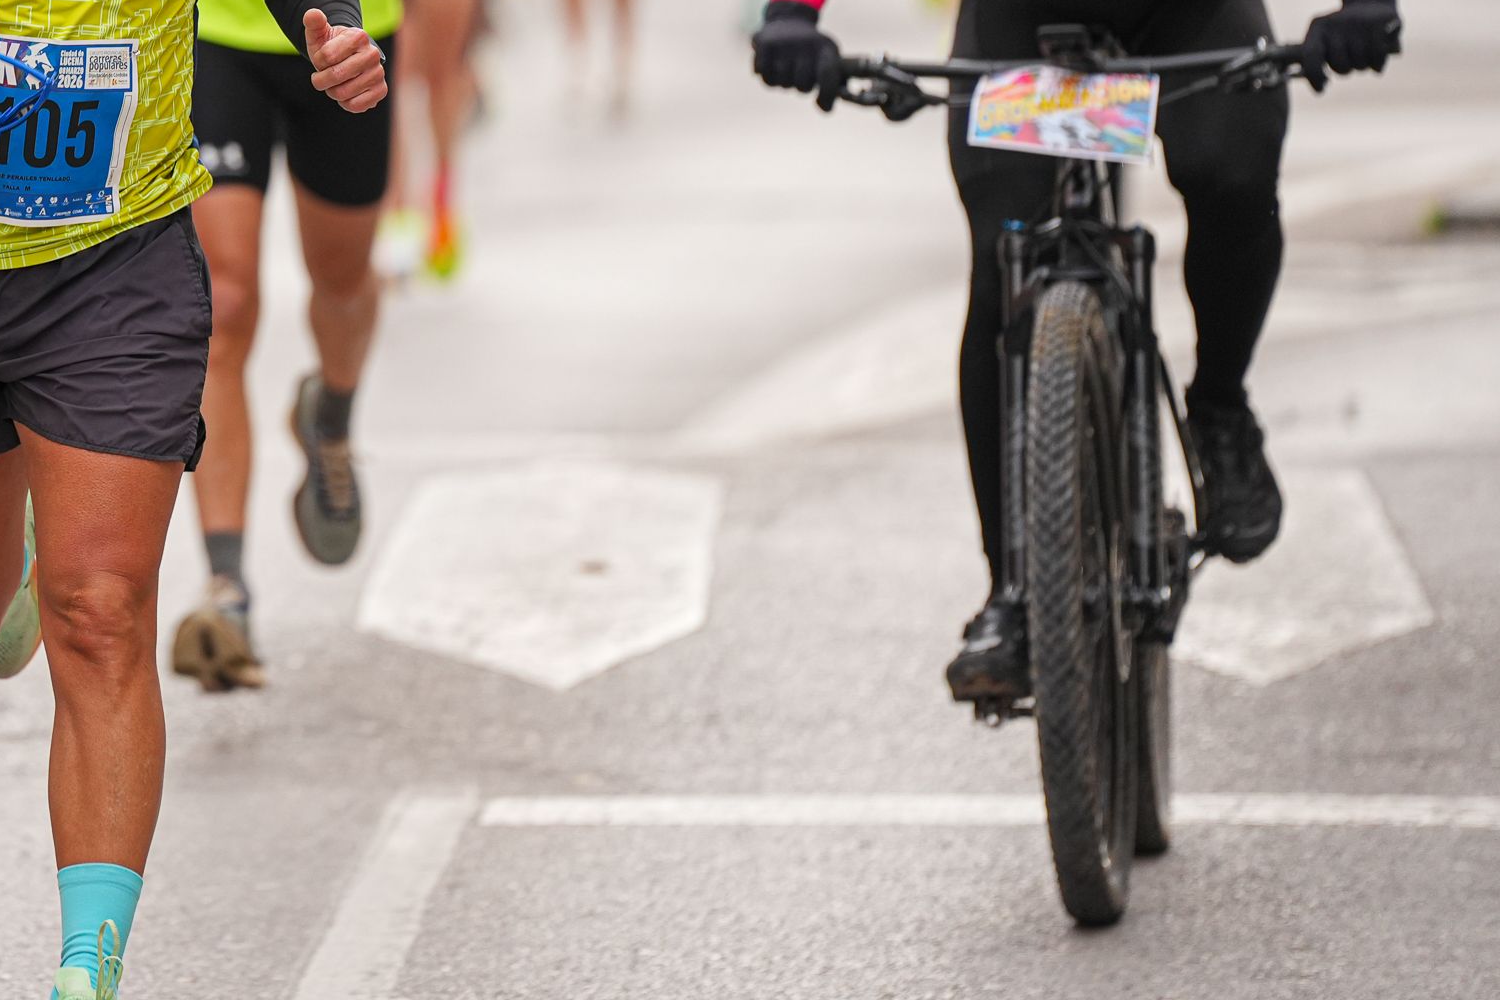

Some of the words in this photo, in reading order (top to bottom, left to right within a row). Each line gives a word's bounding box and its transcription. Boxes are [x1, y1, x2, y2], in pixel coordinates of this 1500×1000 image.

[60, 56, 84, 66] LUCENA
[89, 55, 122, 63] carreras
[89, 60, 128, 72] populares
[57, 74, 83, 88] 2026
